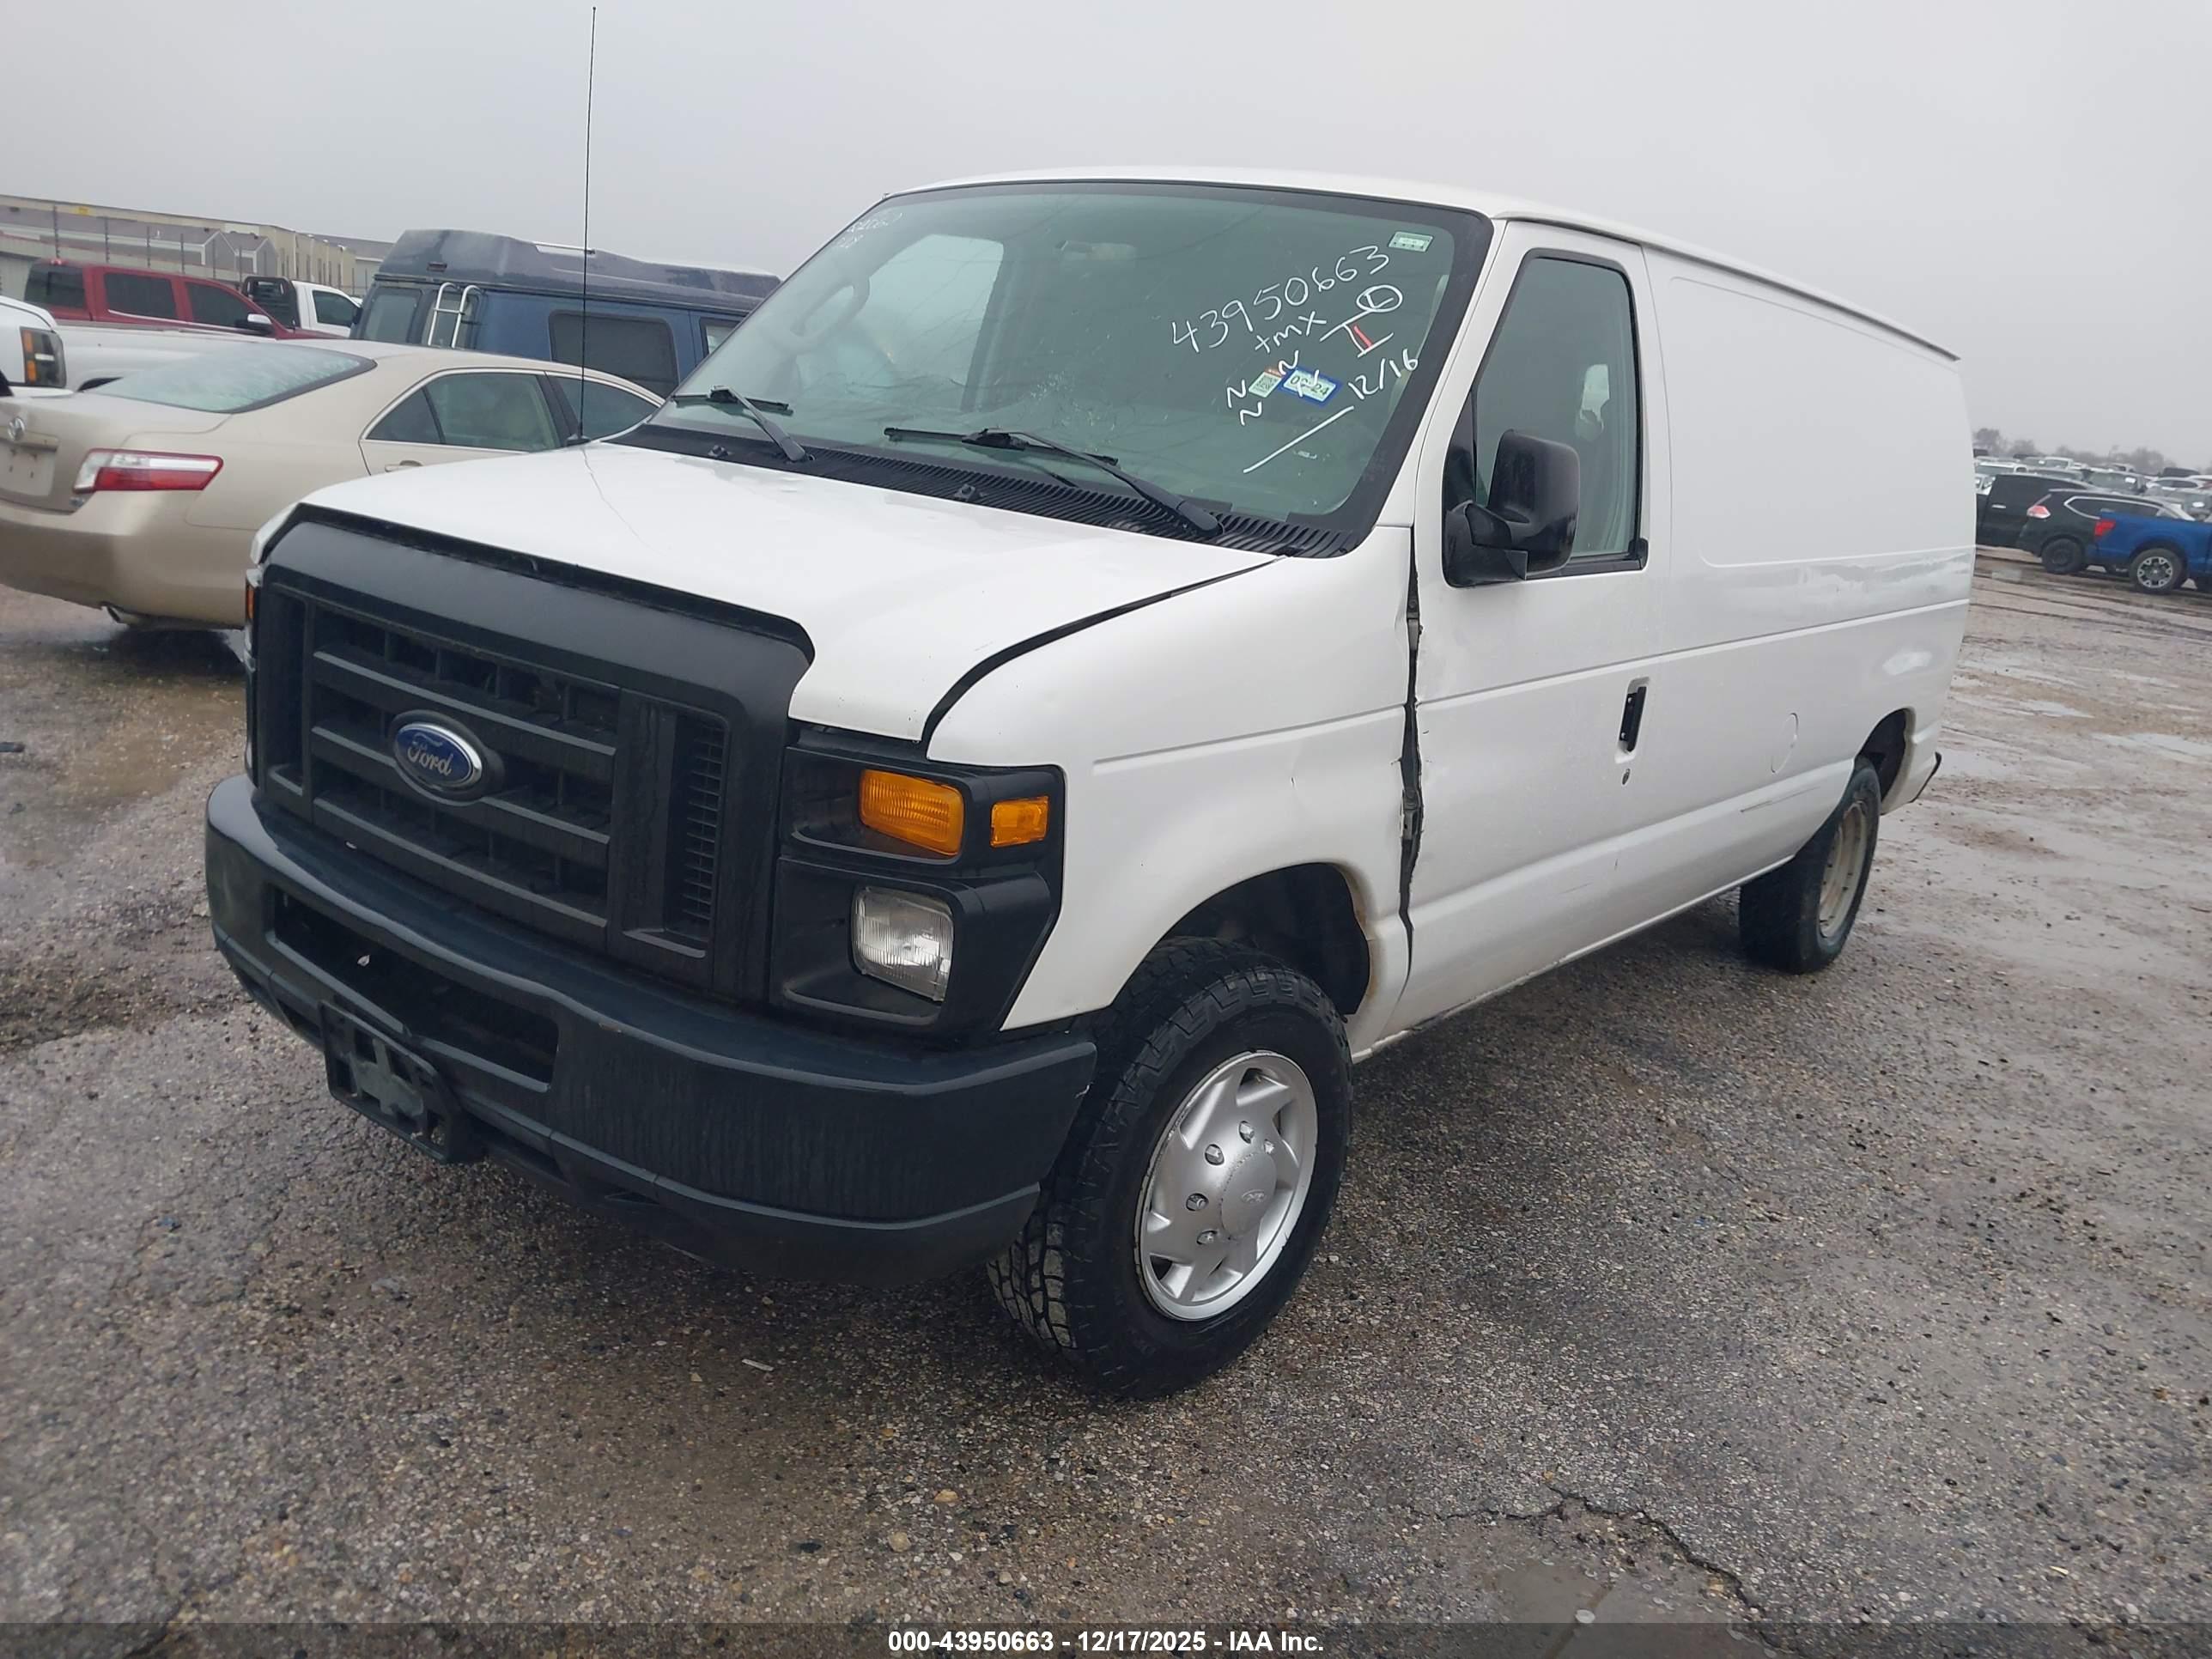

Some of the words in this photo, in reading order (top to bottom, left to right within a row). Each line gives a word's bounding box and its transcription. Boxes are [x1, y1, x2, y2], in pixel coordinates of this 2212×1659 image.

[1171, 245, 1389, 353] 43950663
[1348, 348, 1419, 400] 12/16
[407, 732, 453, 776] Ford
